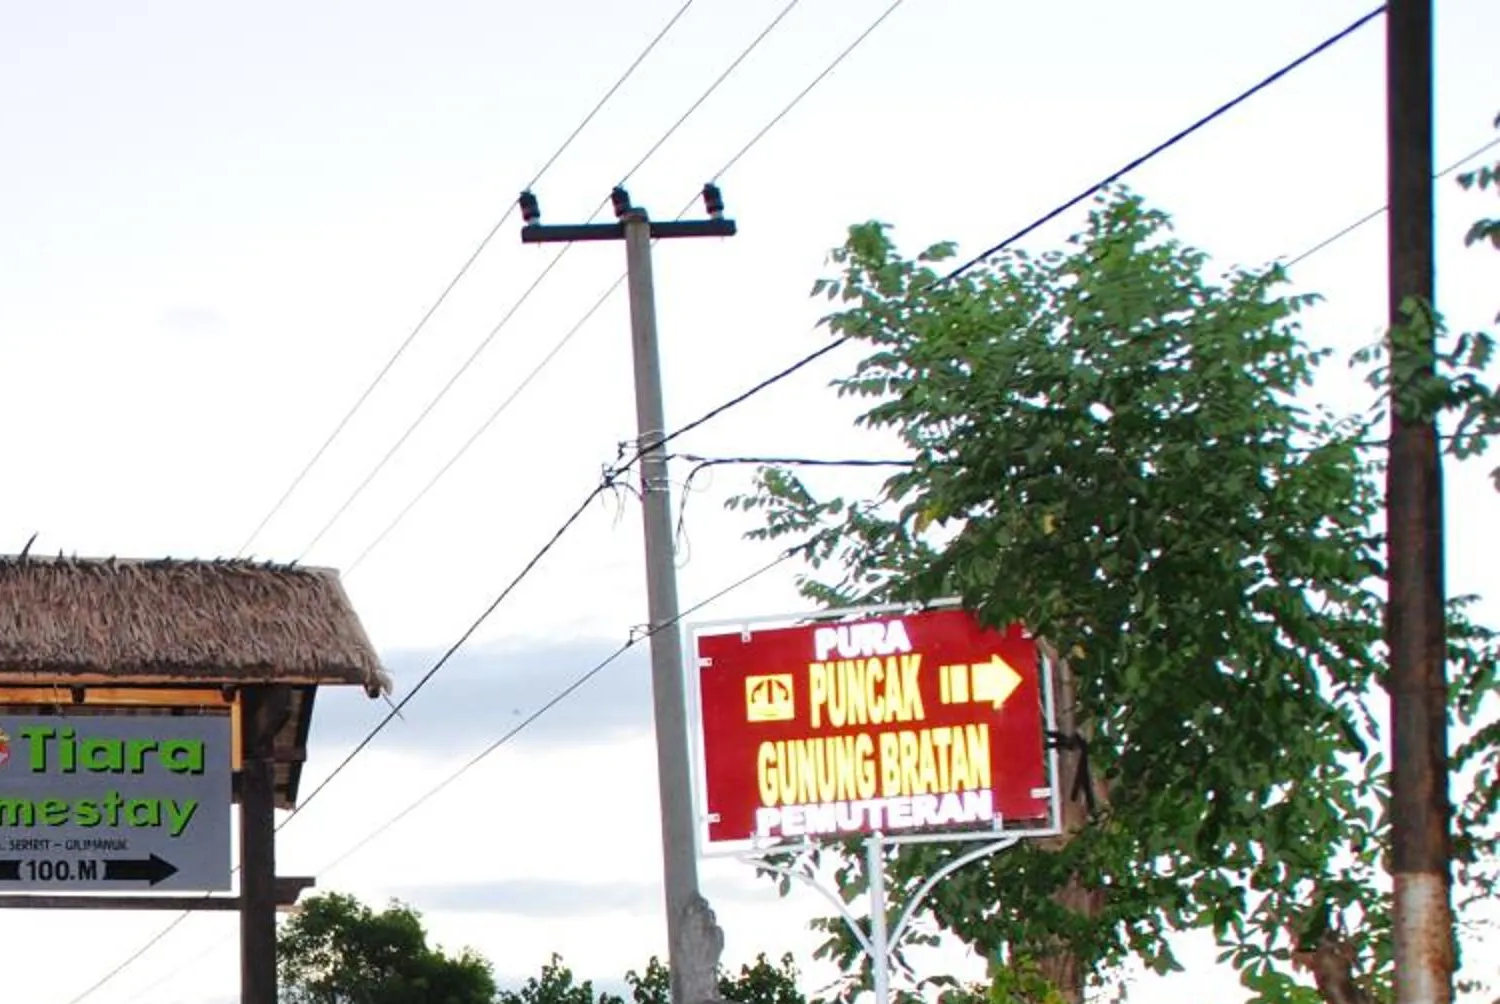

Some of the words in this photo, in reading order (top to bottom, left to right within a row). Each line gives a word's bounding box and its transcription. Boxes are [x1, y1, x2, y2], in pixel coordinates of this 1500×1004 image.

[814, 620, 911, 660] PURA
[809, 654, 924, 728] PUNCAK
[21, 726, 206, 775] Tiara
[757, 734, 876, 806] GUNUNG
[878, 725, 991, 796] BRATAN
[755, 790, 993, 837] PEMUTERAN
